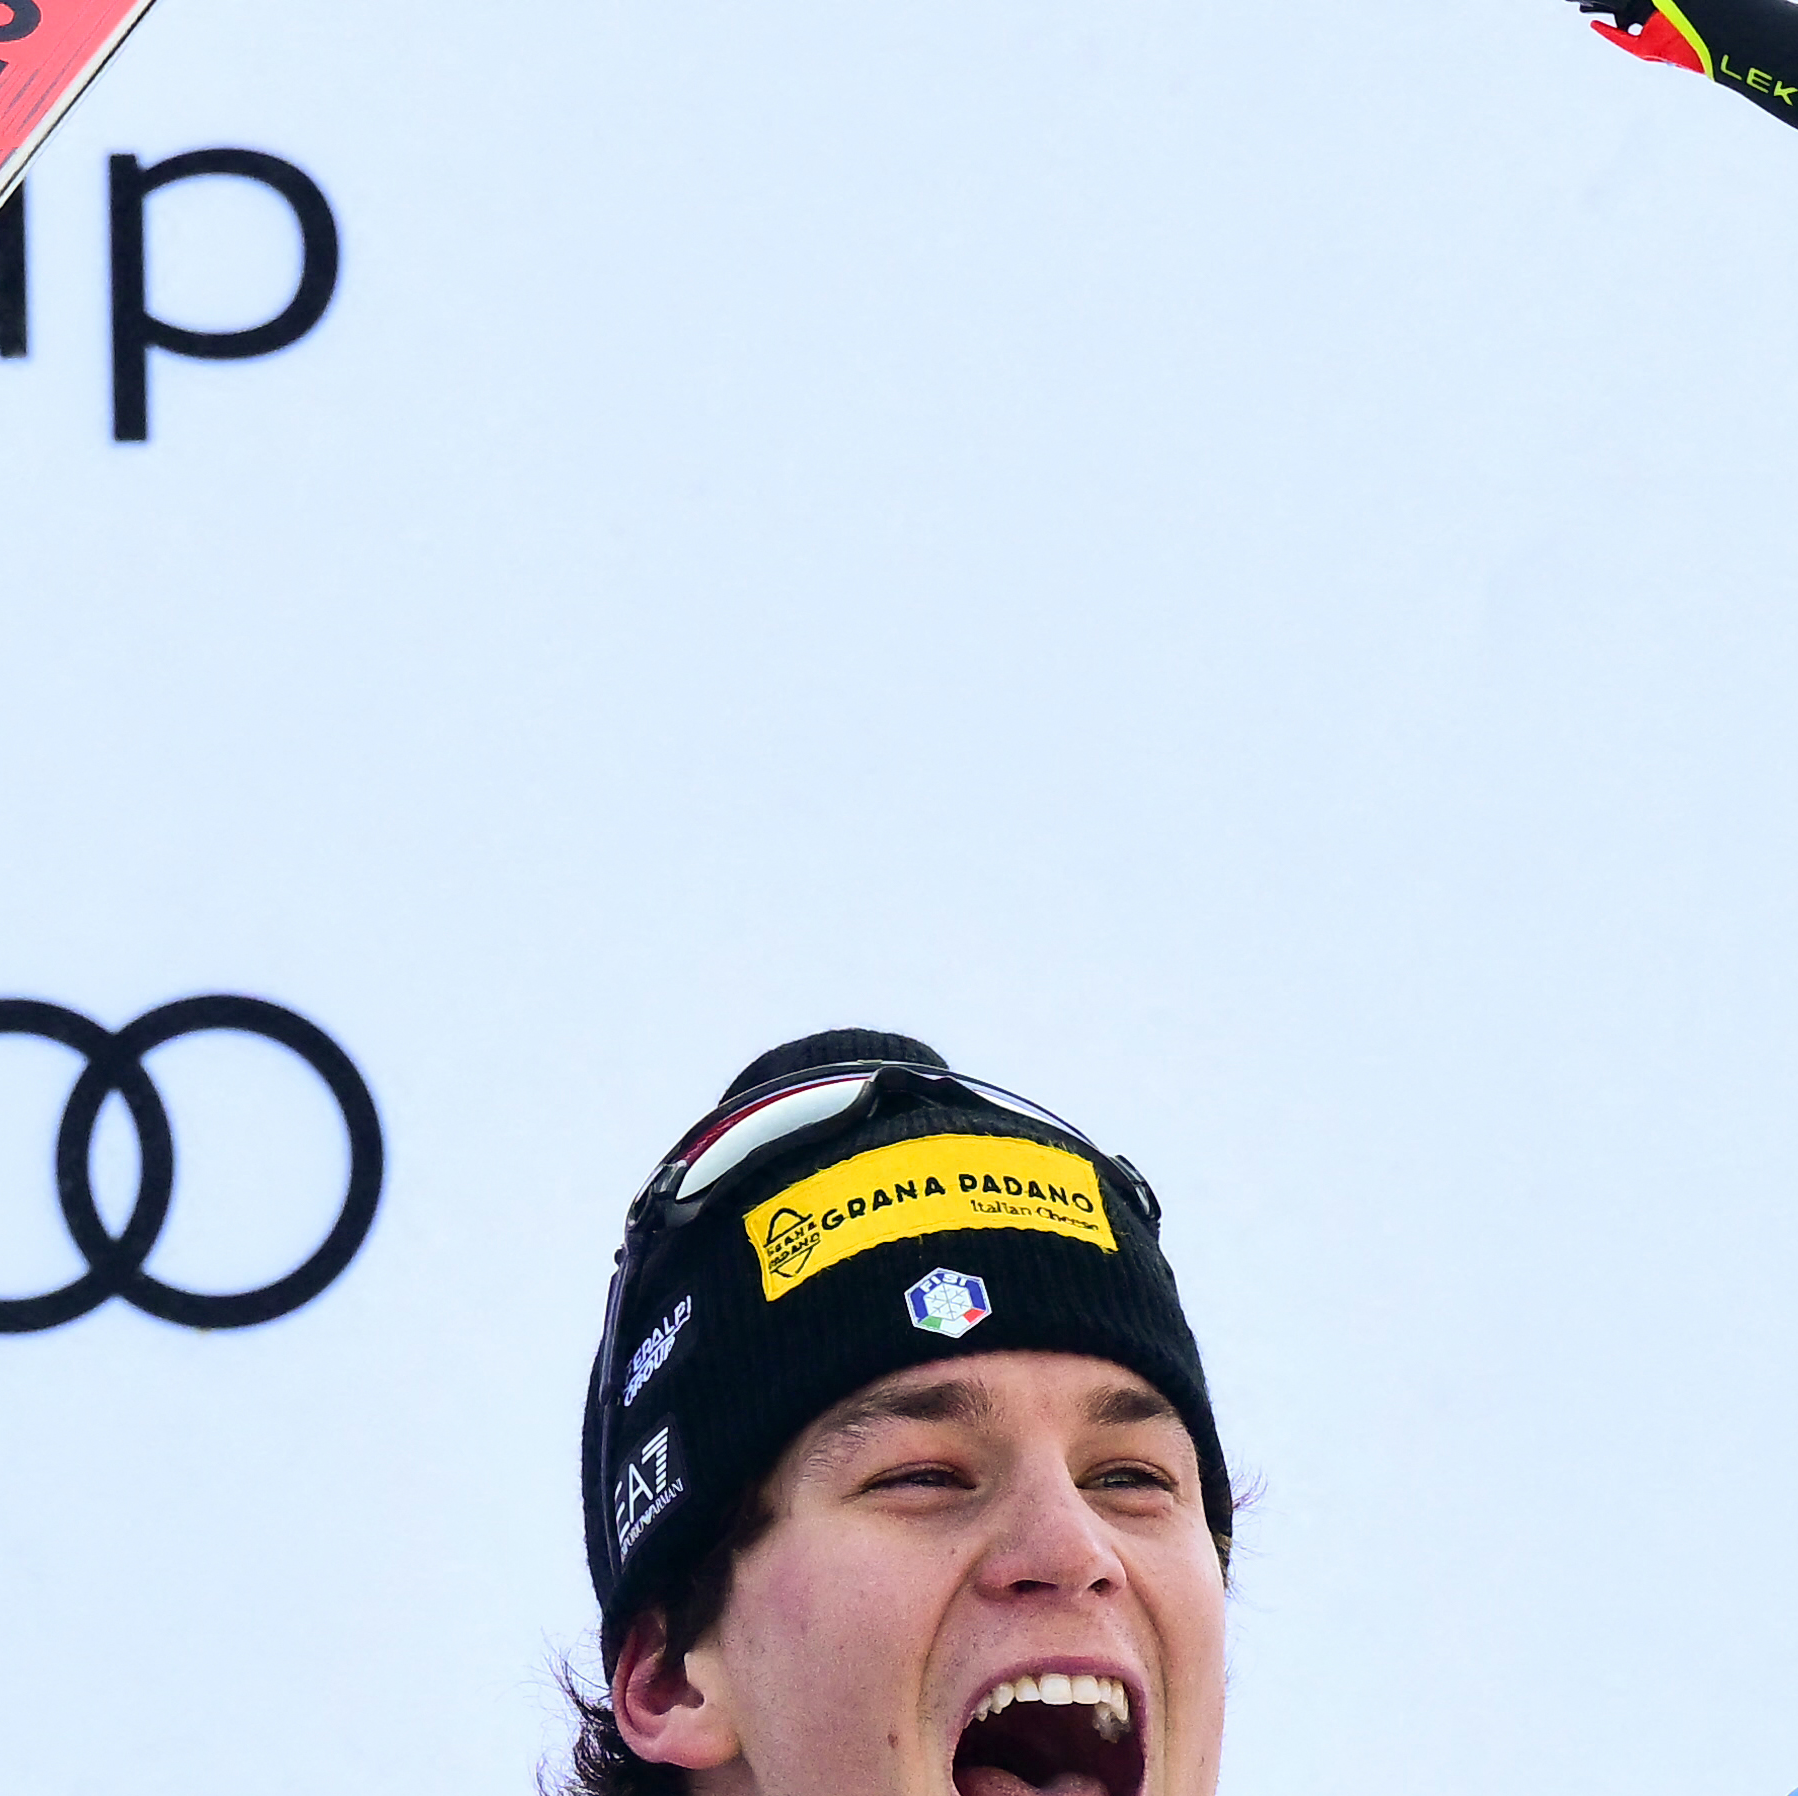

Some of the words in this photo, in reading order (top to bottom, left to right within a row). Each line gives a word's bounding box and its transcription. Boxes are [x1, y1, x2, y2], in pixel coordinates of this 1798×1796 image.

[821, 1176, 946, 1231] GRANA
[958, 1173, 1094, 1213] PADANO
[970, 1199, 1032, 1216] Italian
[919, 1272, 969, 1294] FISI
